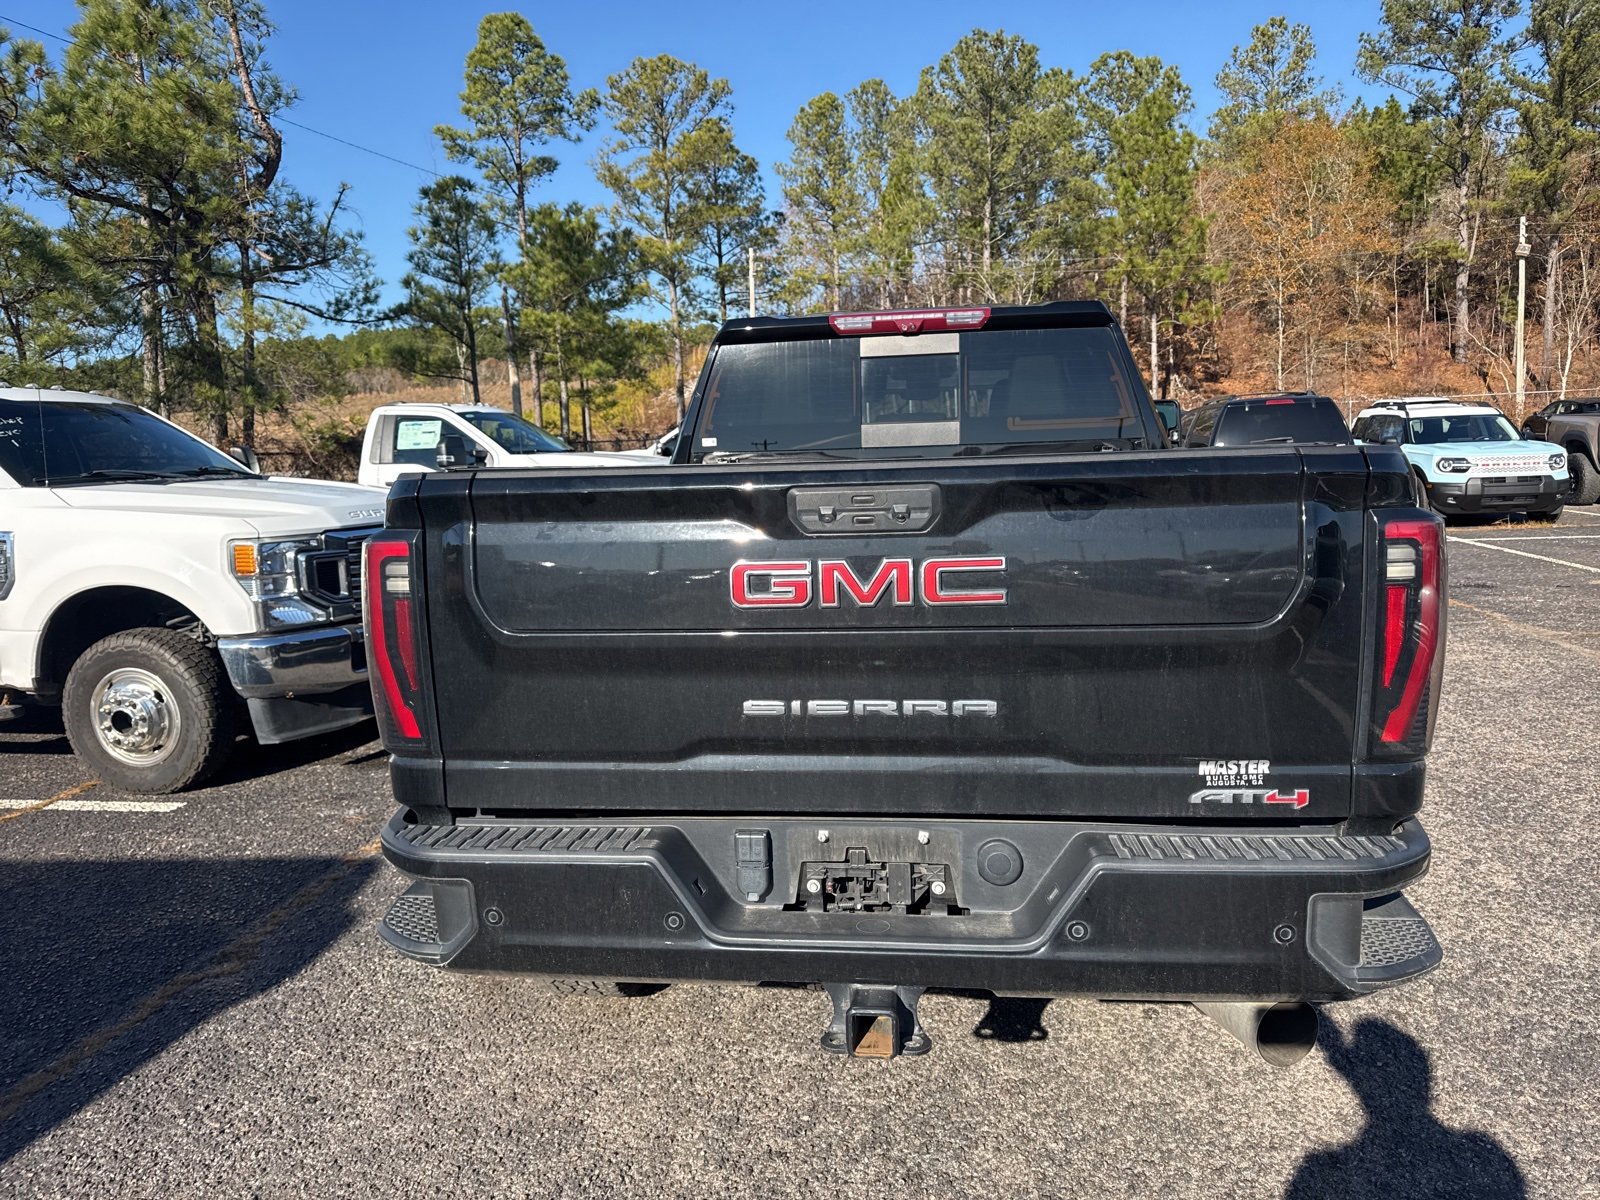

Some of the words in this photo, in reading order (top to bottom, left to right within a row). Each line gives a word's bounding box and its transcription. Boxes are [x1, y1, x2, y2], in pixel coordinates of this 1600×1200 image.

[729, 556, 1008, 609] GMC
[742, 699, 998, 717] SIERRA
[1198, 760, 1271, 775] MASTER
[1188, 789, 1310, 810] AT4
